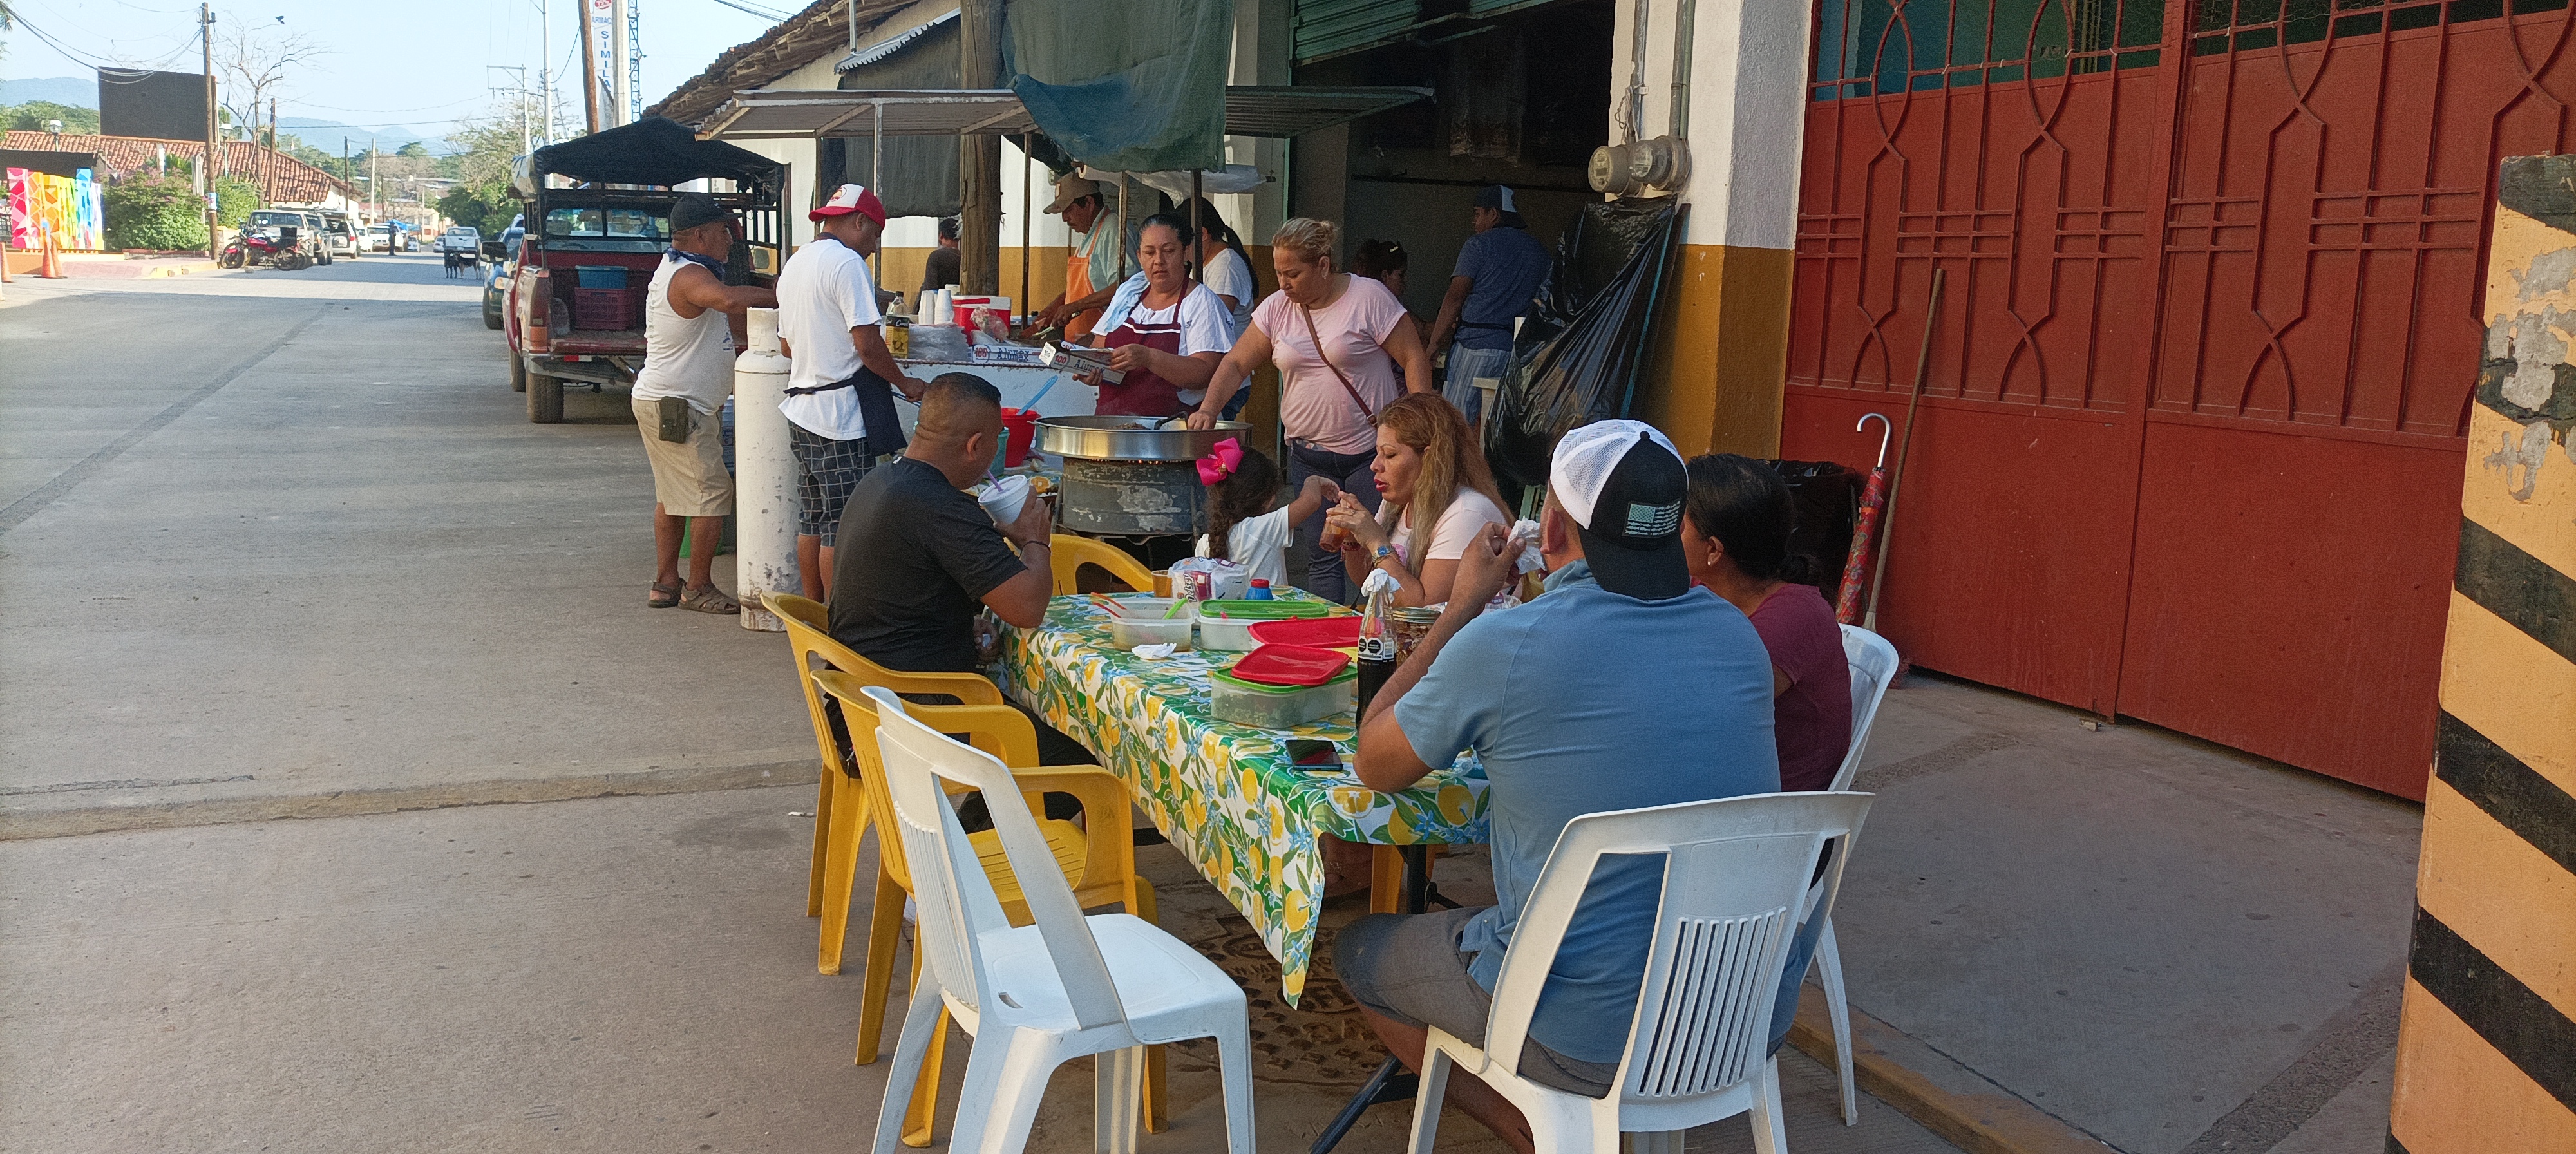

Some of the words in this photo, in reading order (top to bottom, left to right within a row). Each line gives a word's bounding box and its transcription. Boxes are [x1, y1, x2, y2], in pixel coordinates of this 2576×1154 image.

[592, 16, 612, 24] ARMAC
[600, 31, 611, 88] SIMILA
[1055, 355, 1066, 364] 100
[1184, 574, 1197, 602] Delsey
